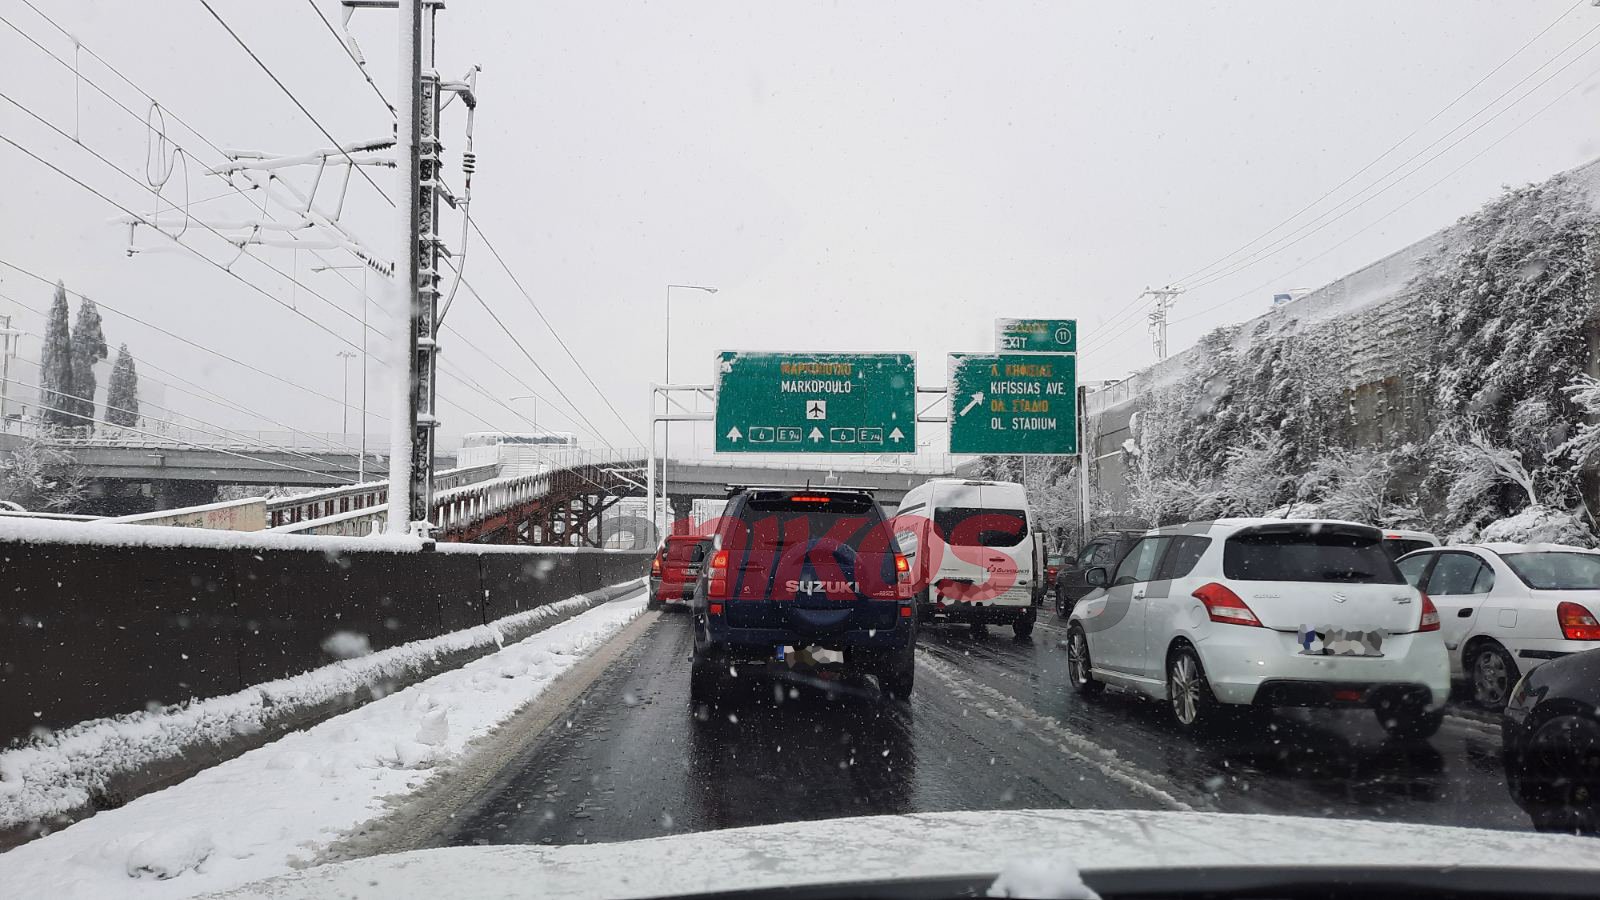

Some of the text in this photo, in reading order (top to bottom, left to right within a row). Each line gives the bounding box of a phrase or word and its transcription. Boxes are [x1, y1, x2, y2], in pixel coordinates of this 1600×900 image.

[1059, 331, 1067, 341] 11
[781, 380, 852, 393] MARKOPOULO
[990, 381, 1066, 395] KIFISSIAS AVE.
[1012, 399, 1048, 412] ΣΤΑΔΙΟ
[991, 417, 1057, 430] OL. STADIUM
[759, 430, 765, 440] 6
[780, 431, 786, 440] E
[840, 431, 846, 440] 6
[861, 431, 867, 440] E
[785, 580, 860, 594] SUZUKI
